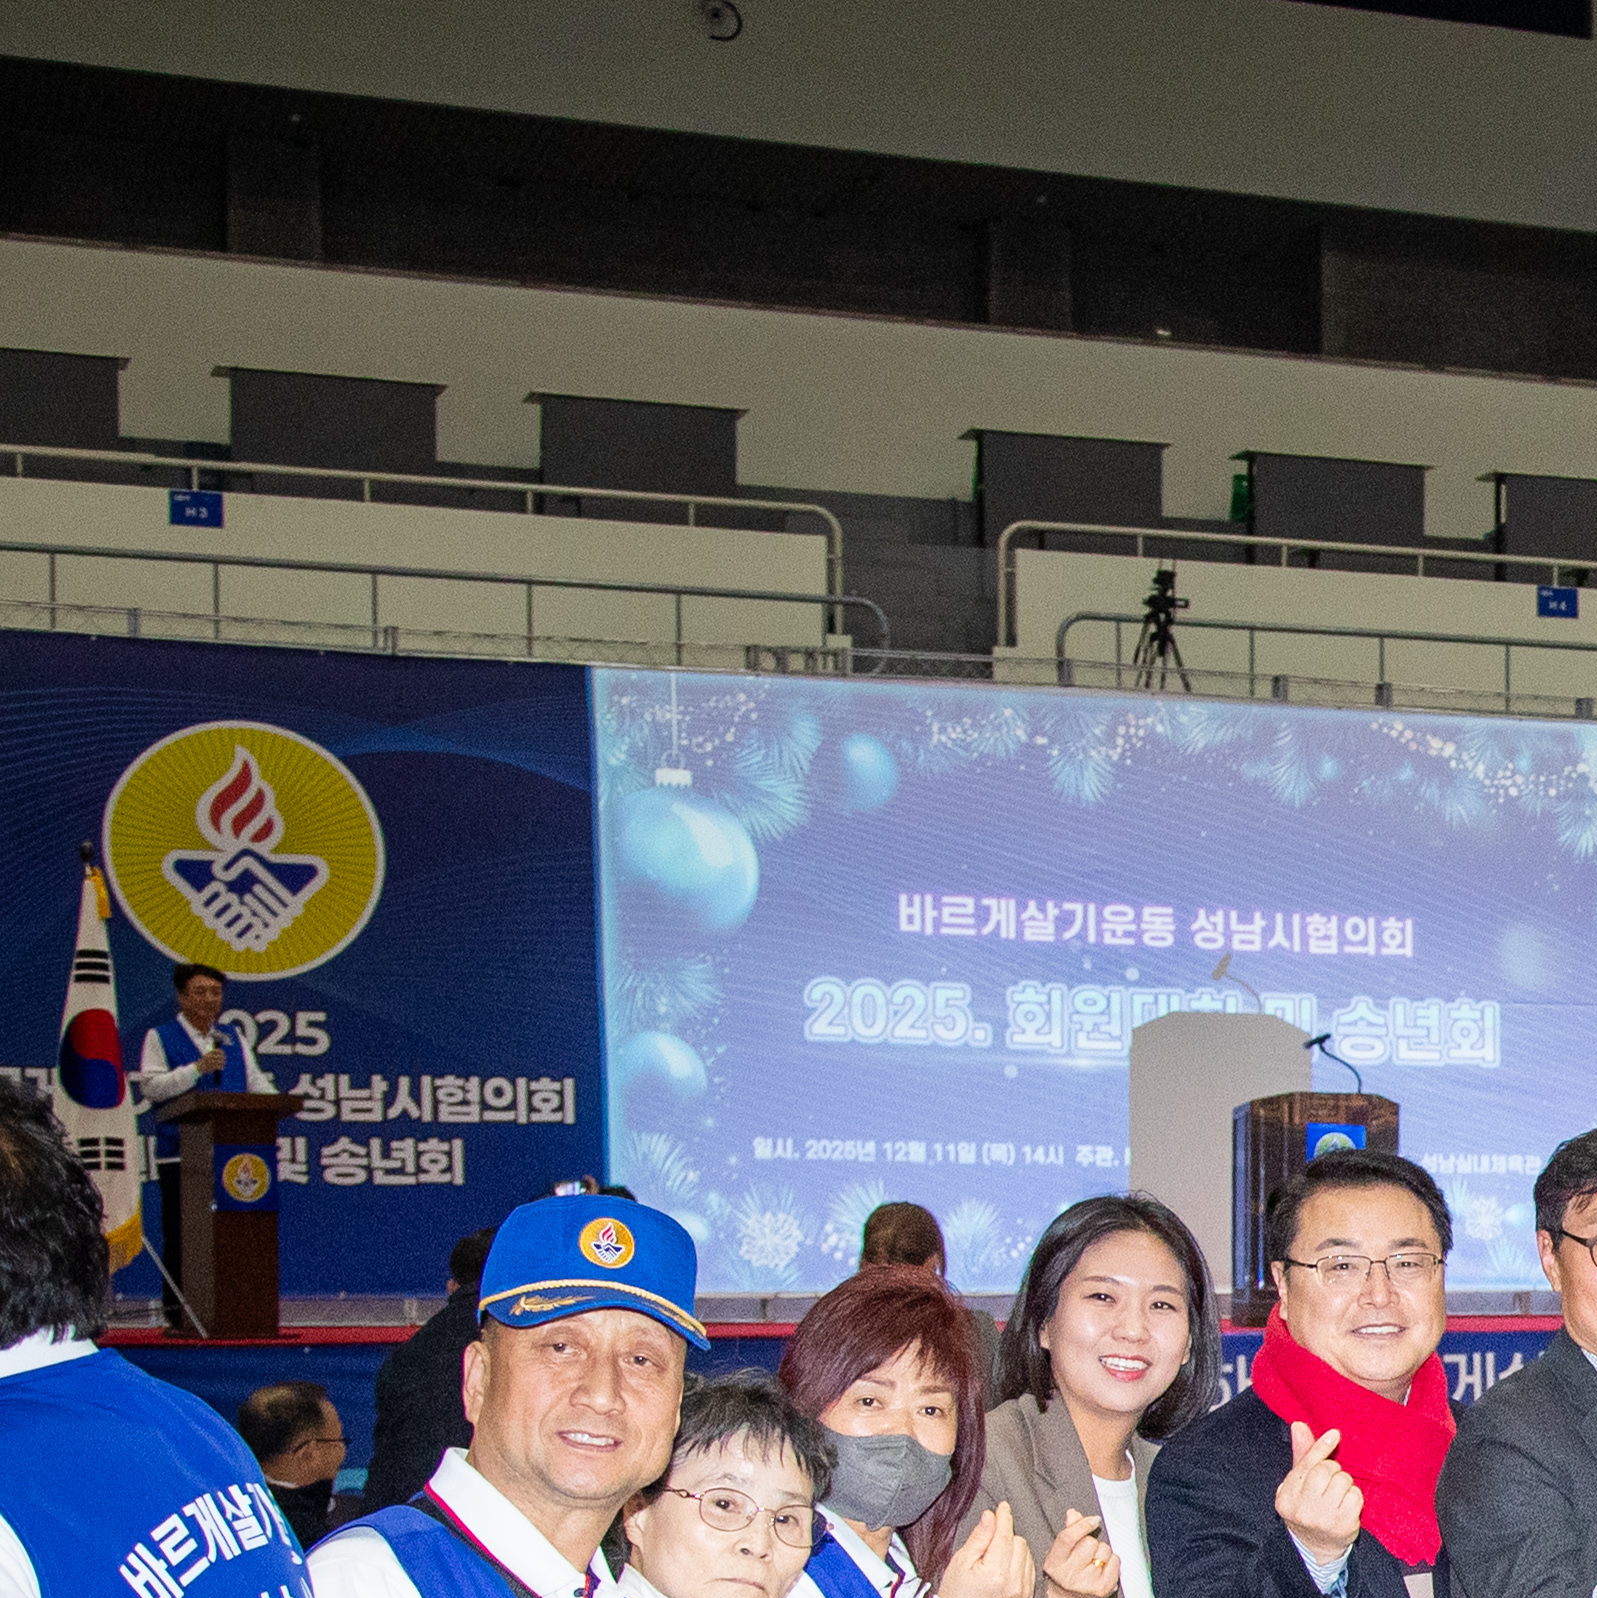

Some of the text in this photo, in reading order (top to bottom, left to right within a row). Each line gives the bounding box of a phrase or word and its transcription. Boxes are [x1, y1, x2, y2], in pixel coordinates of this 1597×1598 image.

[899, 894, 1415, 957] 바르게살기운동 성남시협의회
[218, 1008, 332, 1057] 025
[804, 976, 992, 1048] 2025.
[1330, 993, 1500, 1066] 송년회
[290, 1073, 577, 1125] 성남시협의회
[319, 1135, 466, 1187] 송년회
[804, 1138, 876, 1163] 2025년
[882, 1140, 927, 1164] 12월
[931, 1141, 977, 1165] 11일
[981, 1141, 1016, 1167] (목)
[1021, 1144, 1065, 1166] 14시
